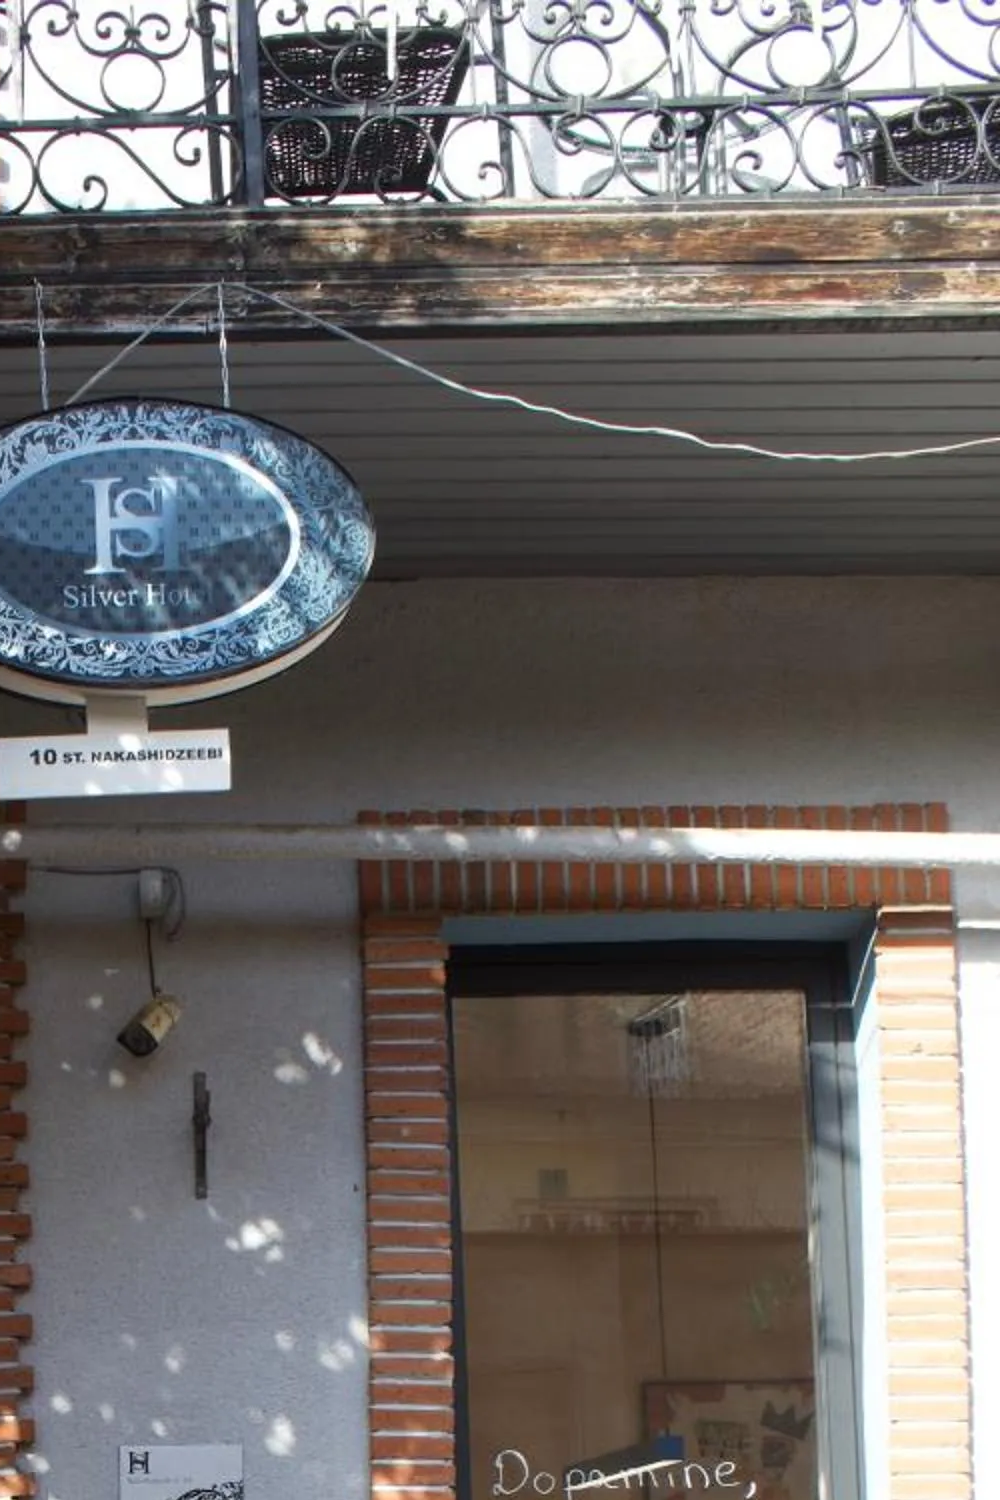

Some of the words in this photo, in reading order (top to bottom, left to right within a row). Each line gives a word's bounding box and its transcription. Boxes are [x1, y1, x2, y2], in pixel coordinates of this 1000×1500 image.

[63, 584, 138, 608] Silver
[29, 748, 57, 765] 10
[63, 753, 86, 764] ST.
[91, 747, 223, 763] NAKASHIDZEEBI
